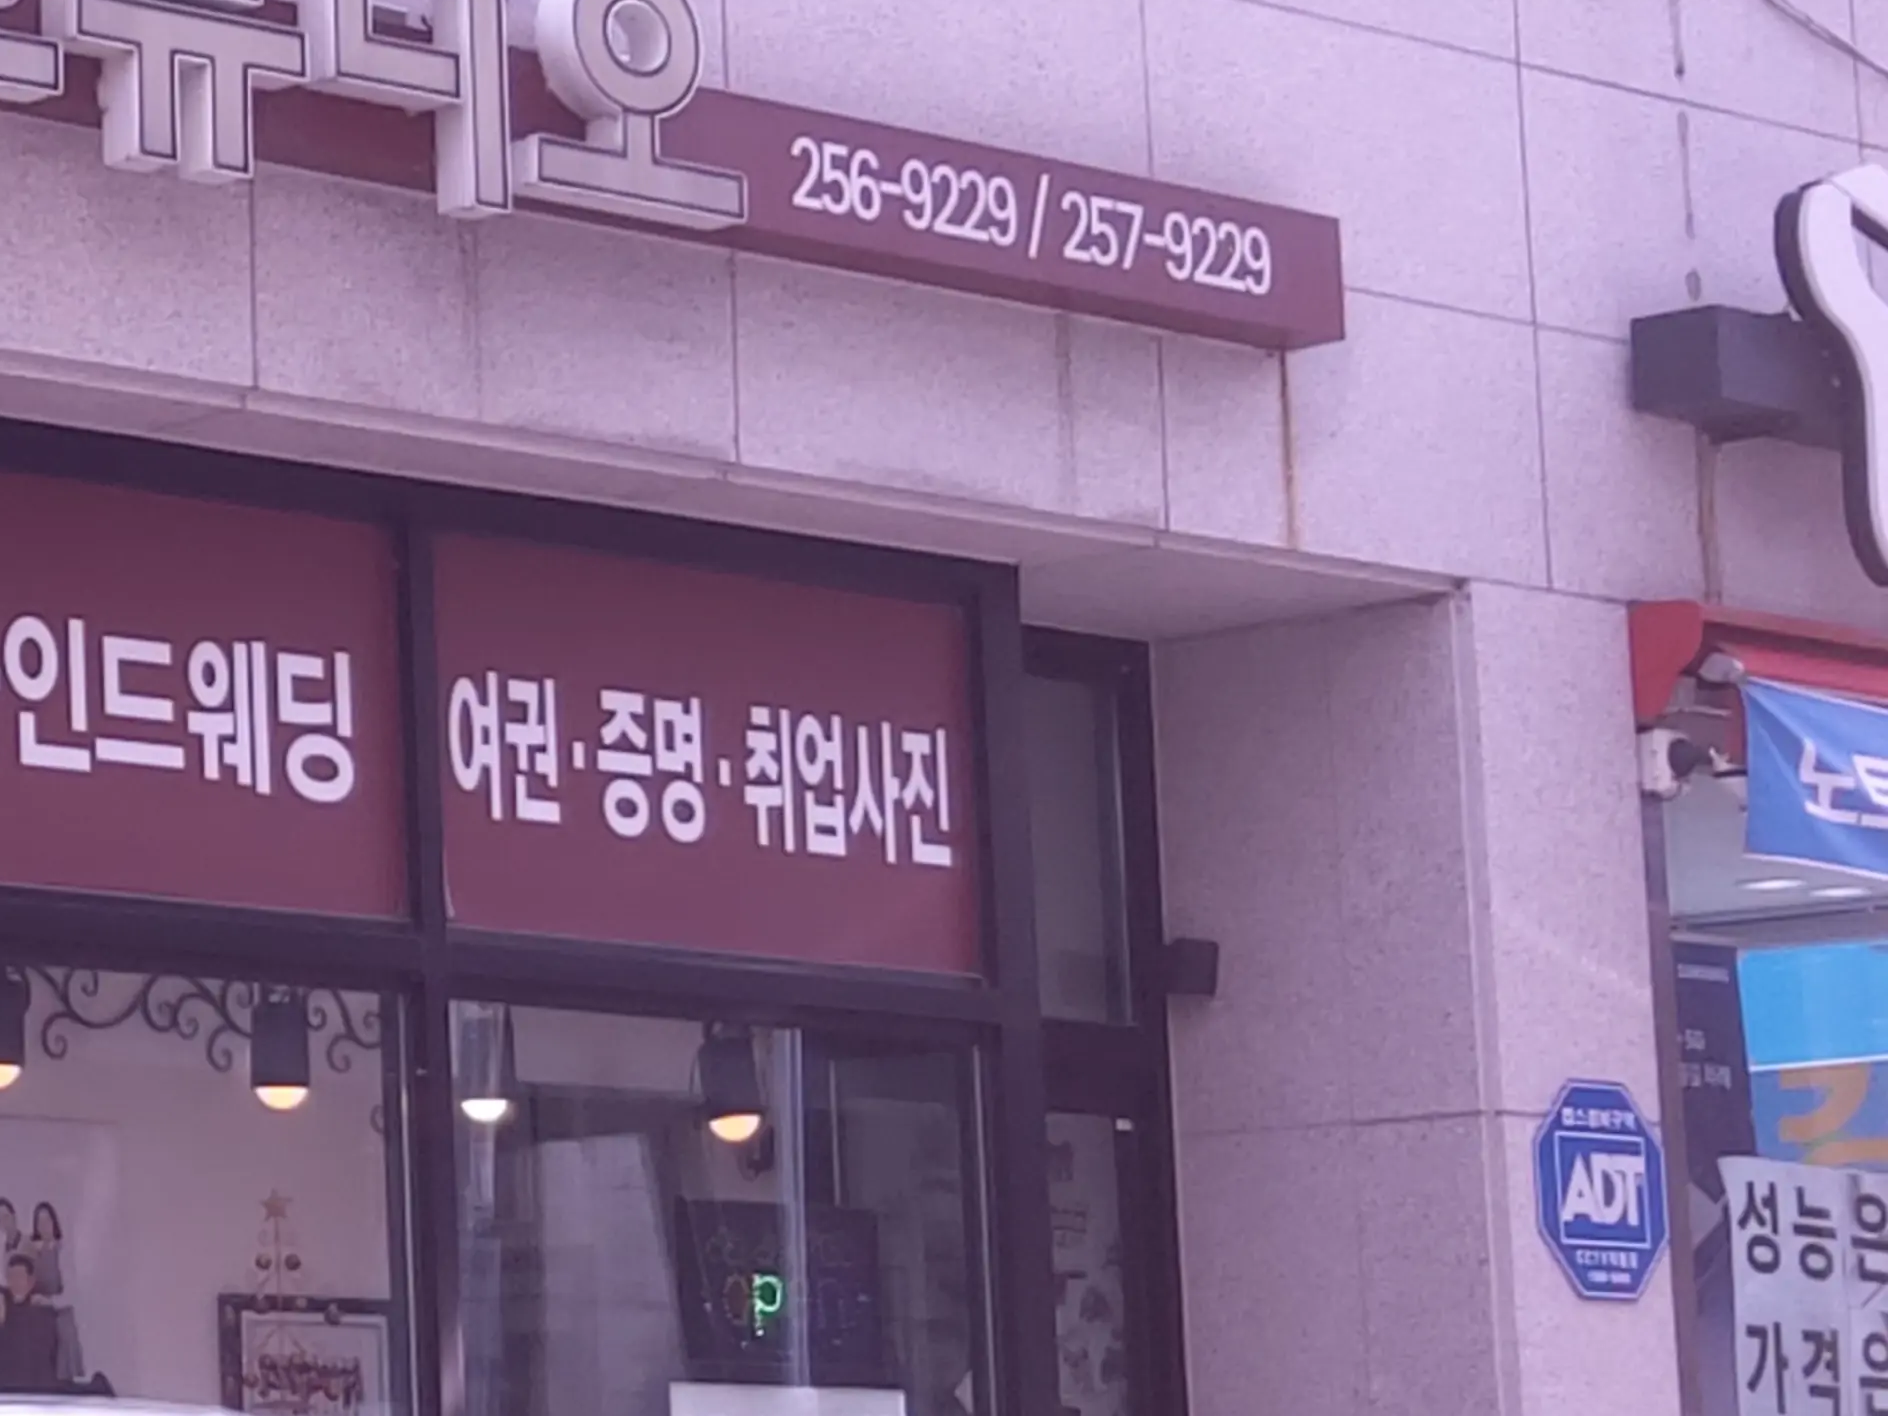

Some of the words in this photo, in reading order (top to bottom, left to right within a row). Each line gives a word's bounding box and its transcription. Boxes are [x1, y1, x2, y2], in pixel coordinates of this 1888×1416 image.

[789, 136, 1020, 246] 256-9229
[1060, 190, 1275, 297] 257-9229
[1562, 1151, 1645, 1227] ADT
